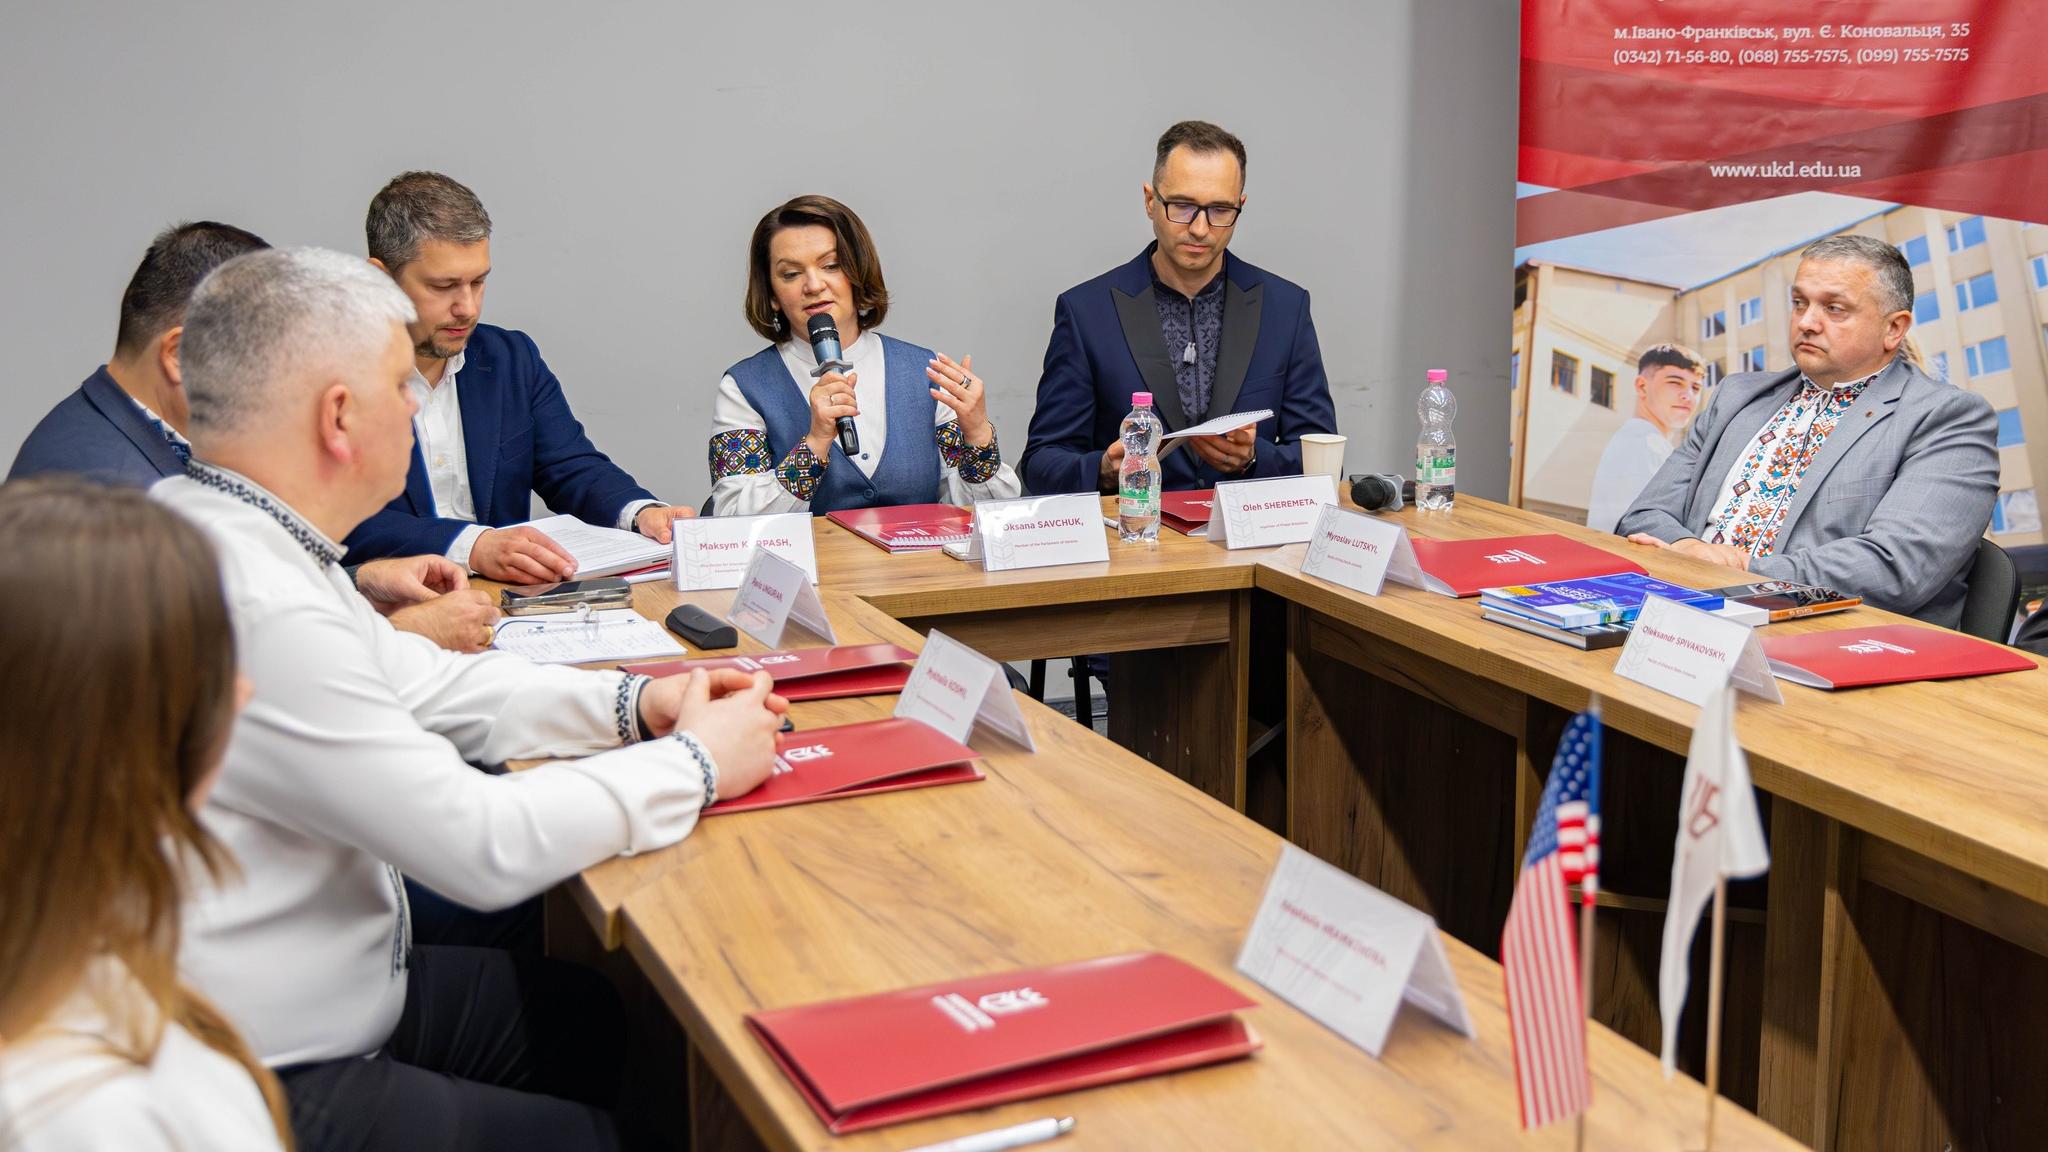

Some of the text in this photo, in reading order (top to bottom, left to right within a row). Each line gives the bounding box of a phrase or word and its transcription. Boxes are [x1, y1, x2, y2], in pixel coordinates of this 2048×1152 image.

[1613, 23, 1970, 43] м.Івано-Франківськ, вул. Є. Коновальця, 35
[1613, 47, 1969, 65] (0342) 71-56-80, (068) 755-7575, (099) 755-7575
[1710, 160, 1862, 178] www.ukd.edu.ua
[1242, 498, 1318, 512] Oleh SHEREMETA,
[1003, 517, 1084, 532] Oksana SAVCHUK,
[1326, 530, 1351, 545] Myroslav
[700, 541, 739, 551] Maksym
[1642, 625, 1675, 643] Oleksandr
